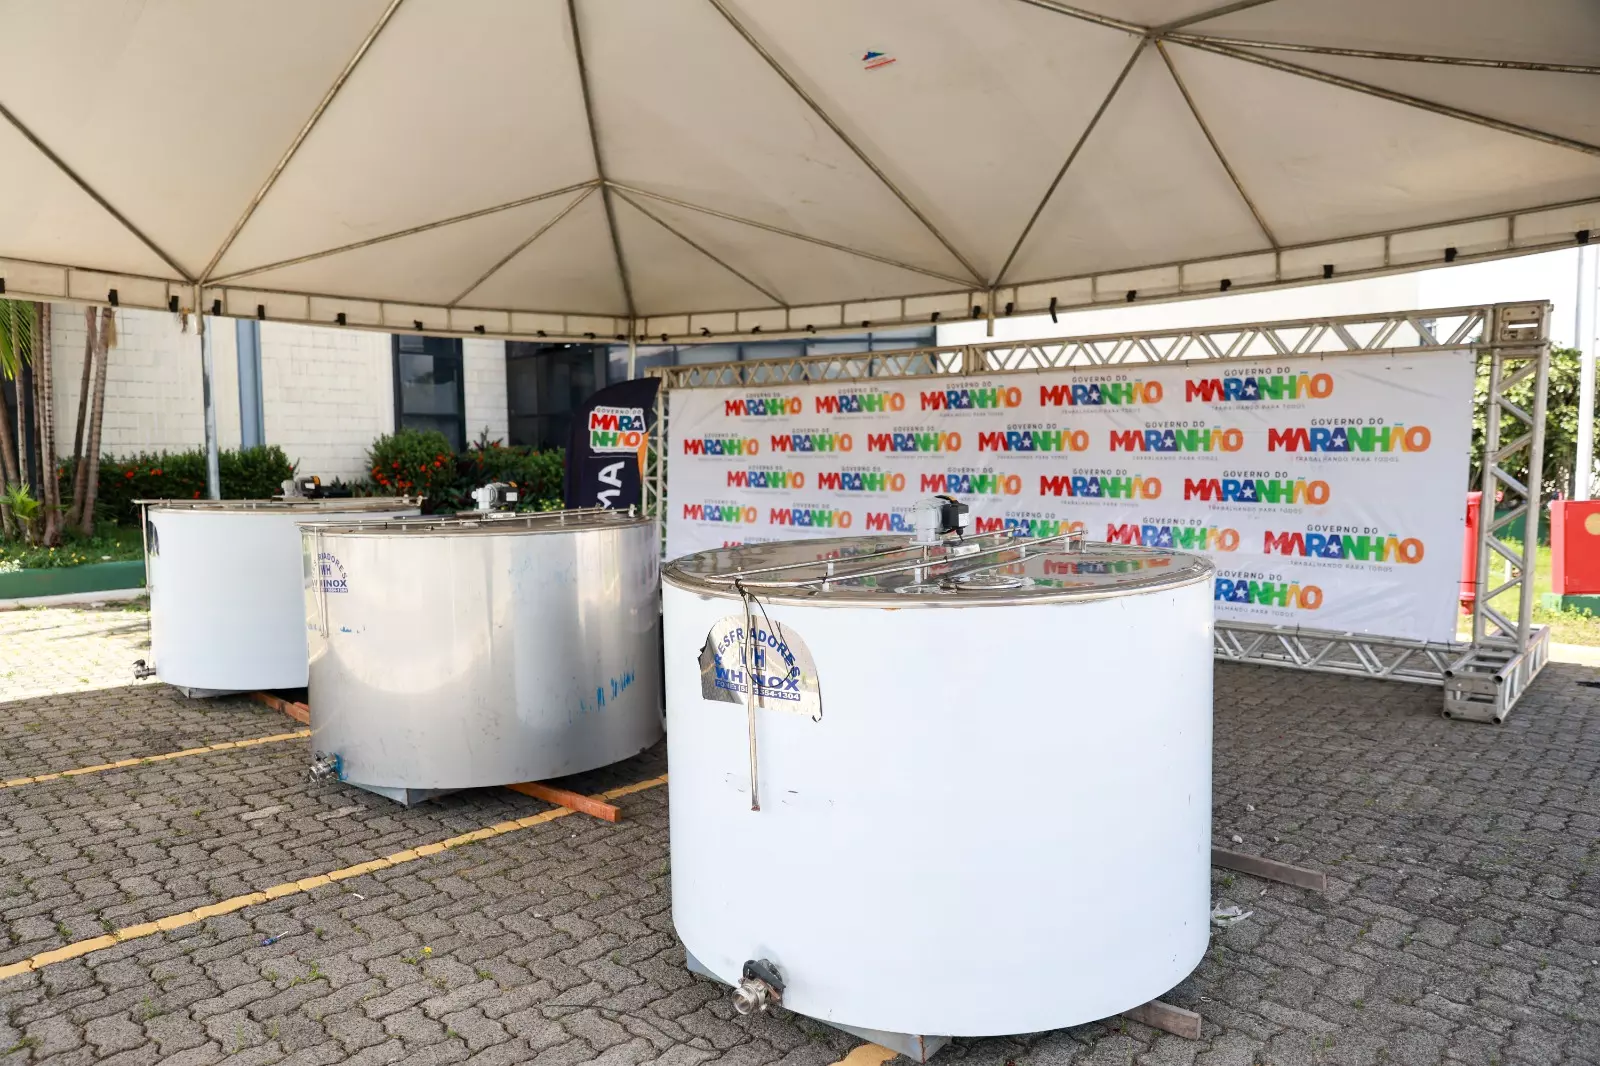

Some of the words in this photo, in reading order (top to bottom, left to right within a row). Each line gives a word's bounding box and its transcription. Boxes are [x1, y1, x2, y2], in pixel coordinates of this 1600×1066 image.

[1224, 368, 1272, 376] GOVERNO
[1276, 366, 1290, 374] DO
[920, 385, 1022, 410] MARANHÃO
[1040, 379, 1163, 406] MARANHÃO
[1186, 371, 1334, 402] MARANHÃO
[725, 396, 802, 416] MARANHÃO
[816, 391, 906, 414] MARANHÃO
[591, 413, 644, 431] MARA
[1311, 418, 1363, 426] GOVERNO
[684, 437, 759, 455] MARANHÃO
[771, 432, 853, 452] MARANHÃO
[867, 430, 962, 452] MARANHÃO
[978, 428, 1089, 452] MARANHÃO
[1110, 425, 1243, 452] MARANHÃO
[1268, 423, 1431, 453] MARANHÃO
[727, 469, 805, 488] MARANHÃO
[818, 471, 906, 492] MARANHÃO
[1072, 468, 1112, 476] GOVERNO
[920, 472, 1022, 495] MARANHÃO
[1040, 473, 1162, 500] MARANHÃO
[1184, 476, 1330, 505] MARANHÃO
[683, 504, 757, 523] MARANHÃO
[770, 507, 852, 528] MARANHÃO
[1106, 524, 1240, 552] MARANHÃO
[1307, 525, 1358, 534] GOVERNO
[1264, 531, 1424, 564] MARANHÃO
[1217, 570, 1264, 579] GOVERNO
[1214, 579, 1323, 610] RANHÃO
[714, 628, 800, 677] RESFRADORES
